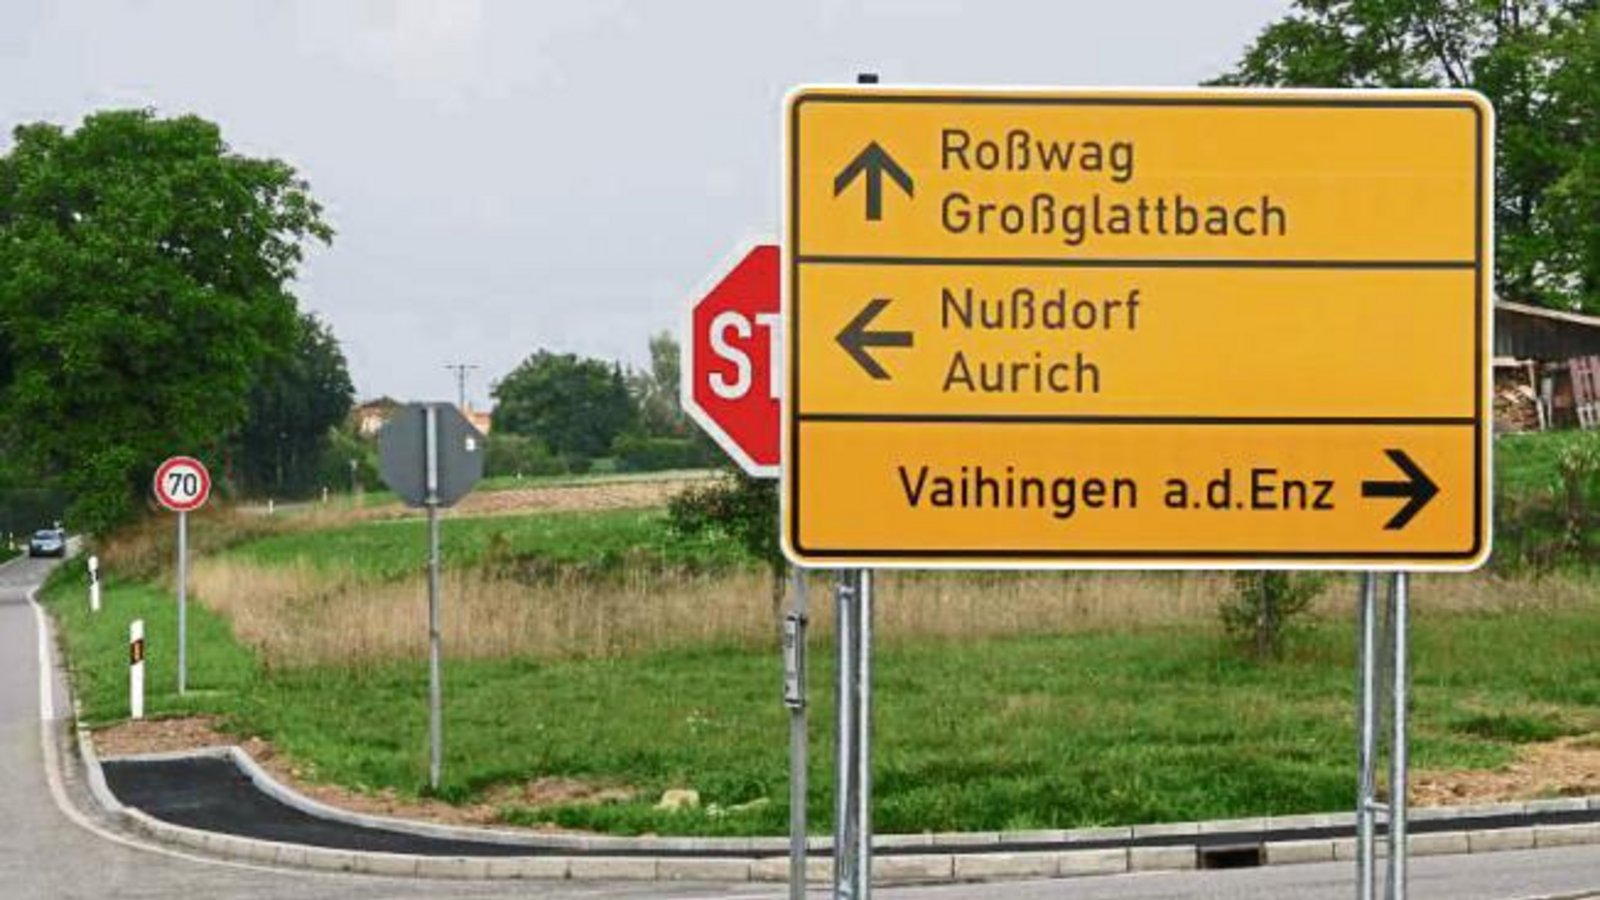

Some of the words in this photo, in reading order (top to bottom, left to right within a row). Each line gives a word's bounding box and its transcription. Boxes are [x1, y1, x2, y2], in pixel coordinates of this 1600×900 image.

[941, 128, 1134, 183] Roßwag
[941, 192, 1287, 246] Großglattbach
[941, 287, 1140, 330] Nußdorf
[942, 350, 1101, 394] Aurich
[169, 473, 197, 496] 70
[898, 465, 1138, 520] Vaihingen
[1163, 467, 1336, 511] a.d.Enz
